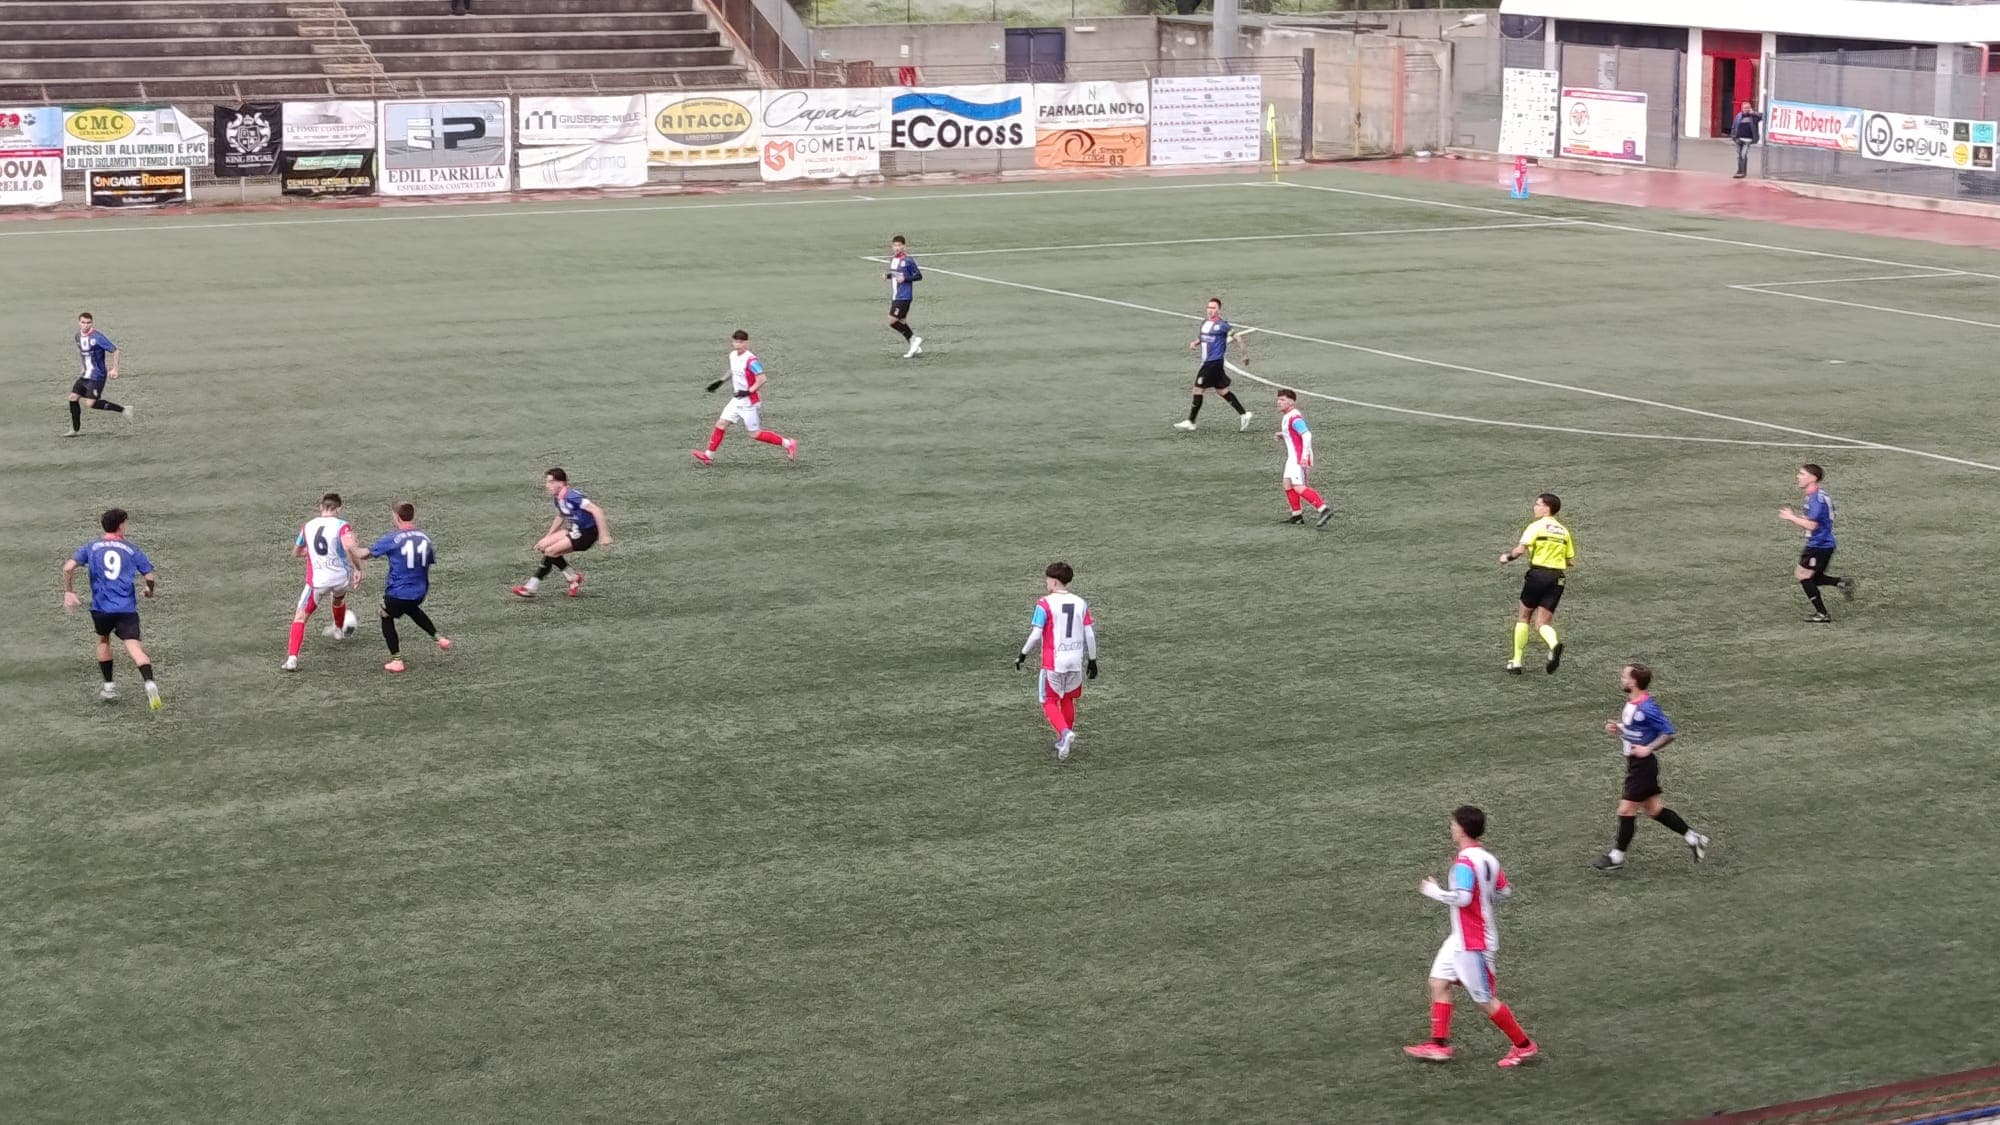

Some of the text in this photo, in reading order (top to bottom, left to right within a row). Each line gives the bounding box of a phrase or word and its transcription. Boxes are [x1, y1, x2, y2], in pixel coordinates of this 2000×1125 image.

[1039, 102, 1145, 118] FARMACIA NOTO
[74, 115, 124, 130] CMC
[559, 114, 610, 124] GIUSEPPE
[662, 113, 746, 129] RITACCA
[1795, 110, 1842, 135] Roberto
[66, 142, 206, 156] INFISSI IN ALLUMINIO E PVC
[795, 136, 876, 154] GOMETAL
[1893, 138, 1948, 157] GROUP
[1109, 154, 1125, 166] 83
[0, 160, 47, 178] OVA
[388, 167, 505, 183] EDIL PARRILLA
[0, 180, 43, 192] ELLO
[314, 525, 328, 556] 6
[401, 540, 428, 569] 11
[103, 550, 121, 580] 9
